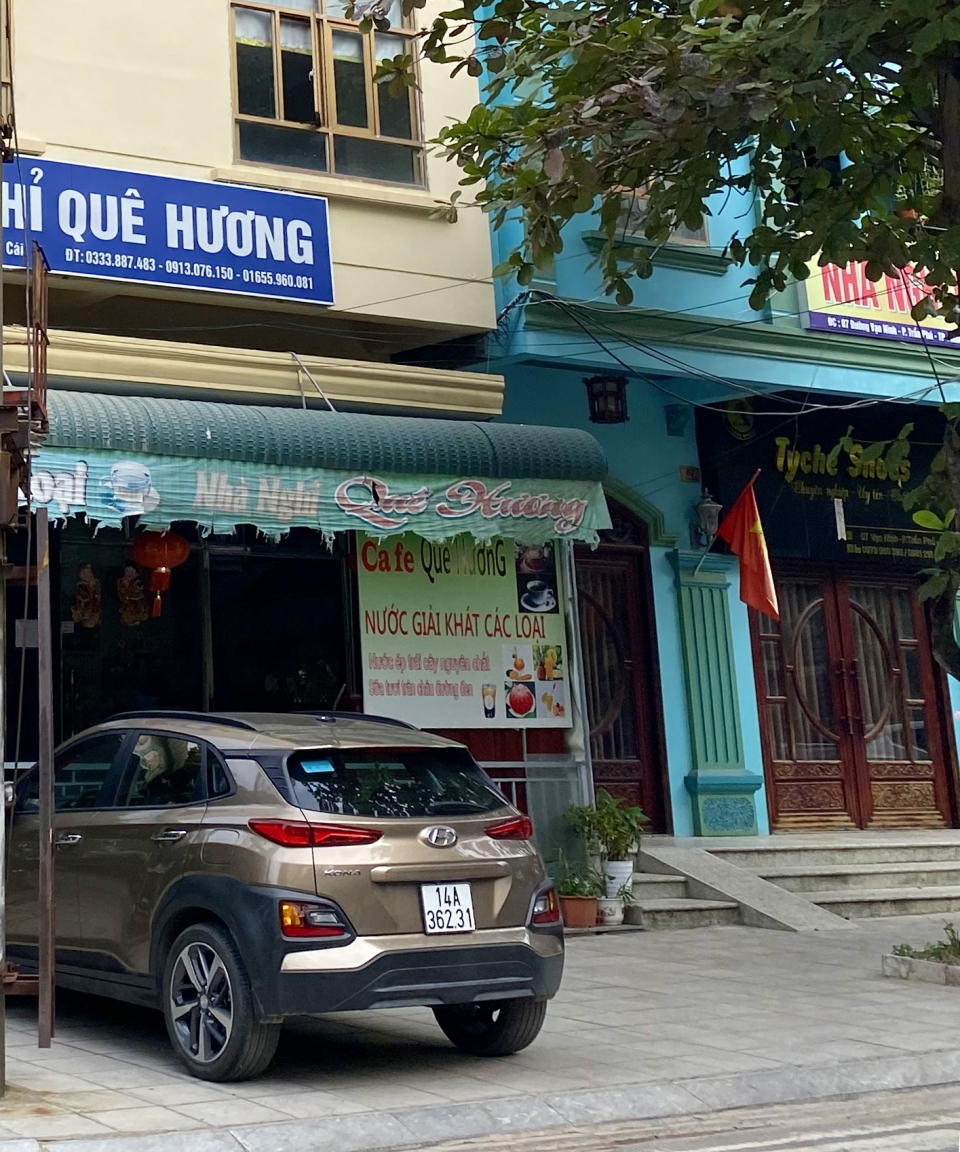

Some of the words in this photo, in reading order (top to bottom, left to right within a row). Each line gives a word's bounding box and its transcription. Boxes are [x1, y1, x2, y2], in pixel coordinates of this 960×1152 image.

[58, 187, 147, 245] QUÊ
[165, 203, 315, 266] HƯƠNG
[5, 240, 24, 257] Cái
[165, 259, 234, 281] 0913.076.150
[242, 269, 314, 290] 01655.960.081
[775, 436, 839, 484] Tyche
[192, 470, 249, 513] Nhà
[334, 474, 432, 529] Quê
[435, 479, 589, 534] Hương
[365, 603, 409, 636] NƯỚC
[412, 603, 442, 637] GIẢI
[444, 605, 480, 638] KHÁT
[484, 606, 512, 639] CÁC
[515, 614, 546, 644] LOẠI
[368, 652, 394, 671] Nước
[423, 652, 440, 674] cây
[440, 654, 471, 675] nguyên
[324, 869, 362, 877] KONA
[435, 886, 461, 907] 14A
[426, 907, 473, 930] 362.31
